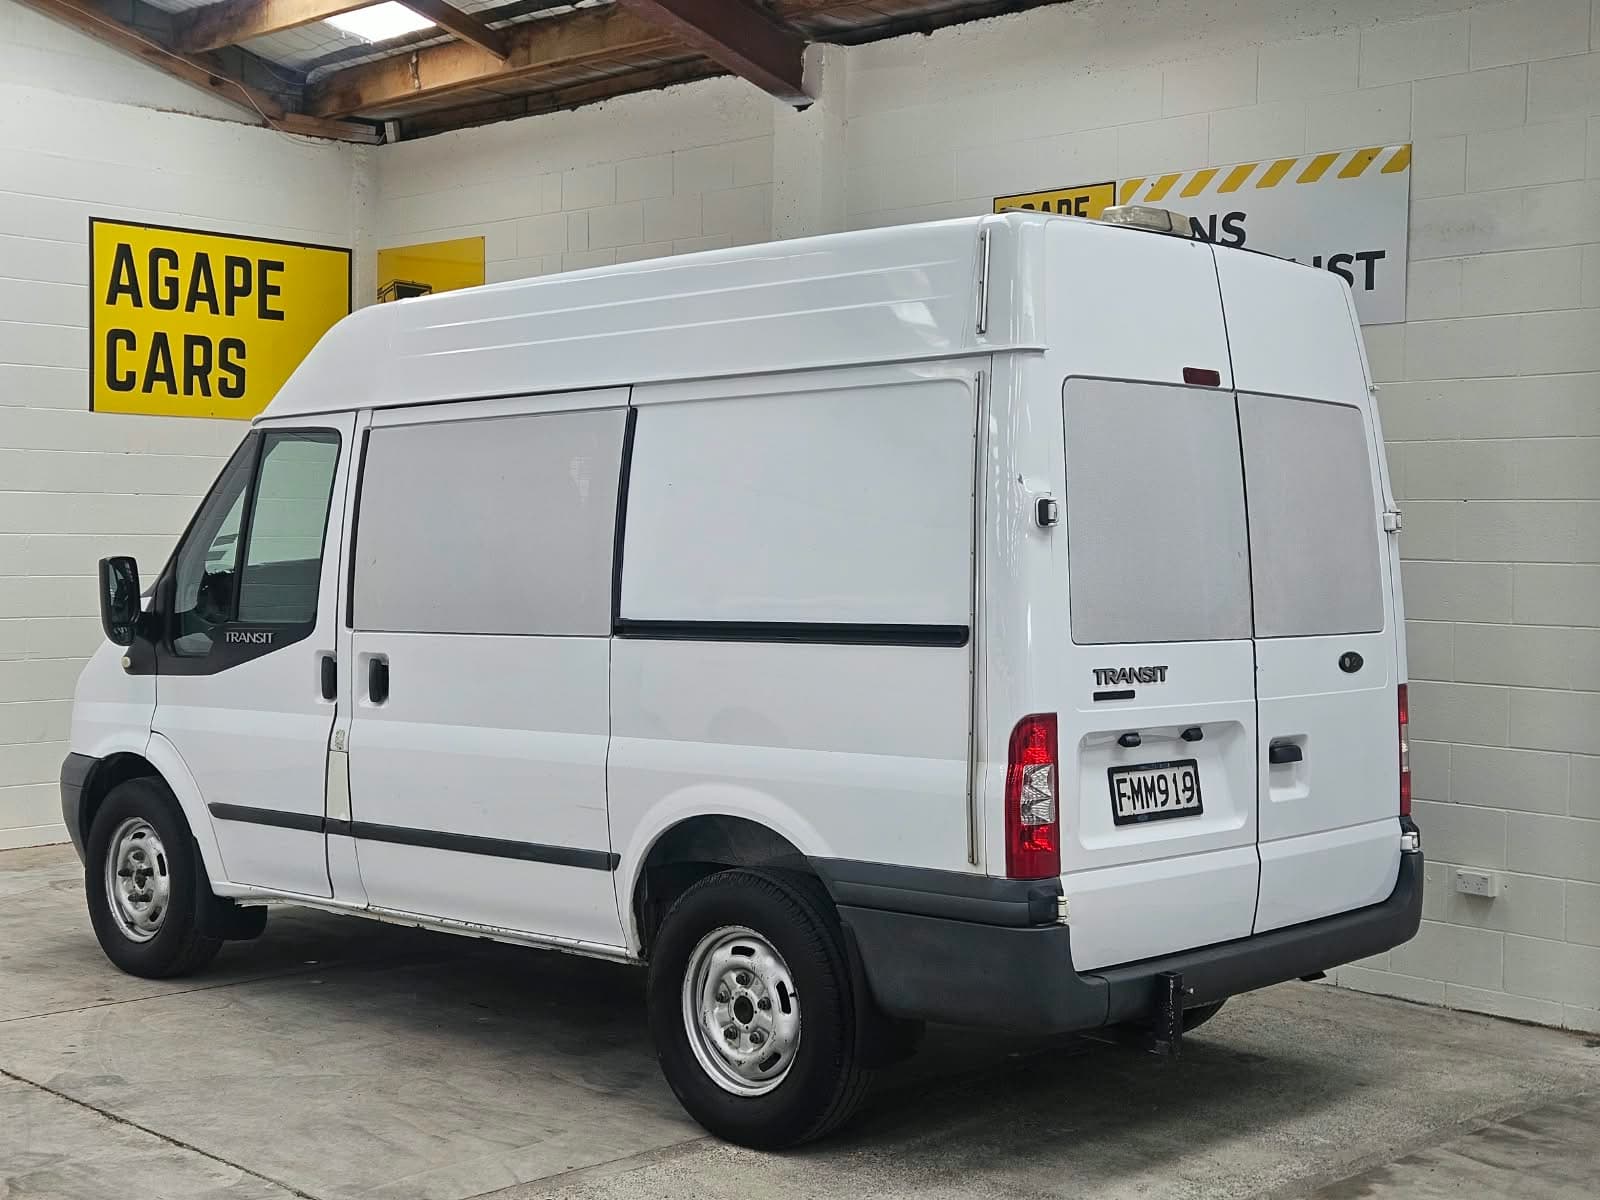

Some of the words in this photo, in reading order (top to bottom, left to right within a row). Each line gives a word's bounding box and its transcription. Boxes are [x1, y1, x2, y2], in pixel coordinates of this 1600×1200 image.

[105, 243, 285, 320] AGAPE
[106, 328, 247, 399] CARS
[225, 631, 274, 644] TRANSIT
[1092, 666, 1168, 685] TRANSIT
[1116, 771, 1195, 812] FMM919
